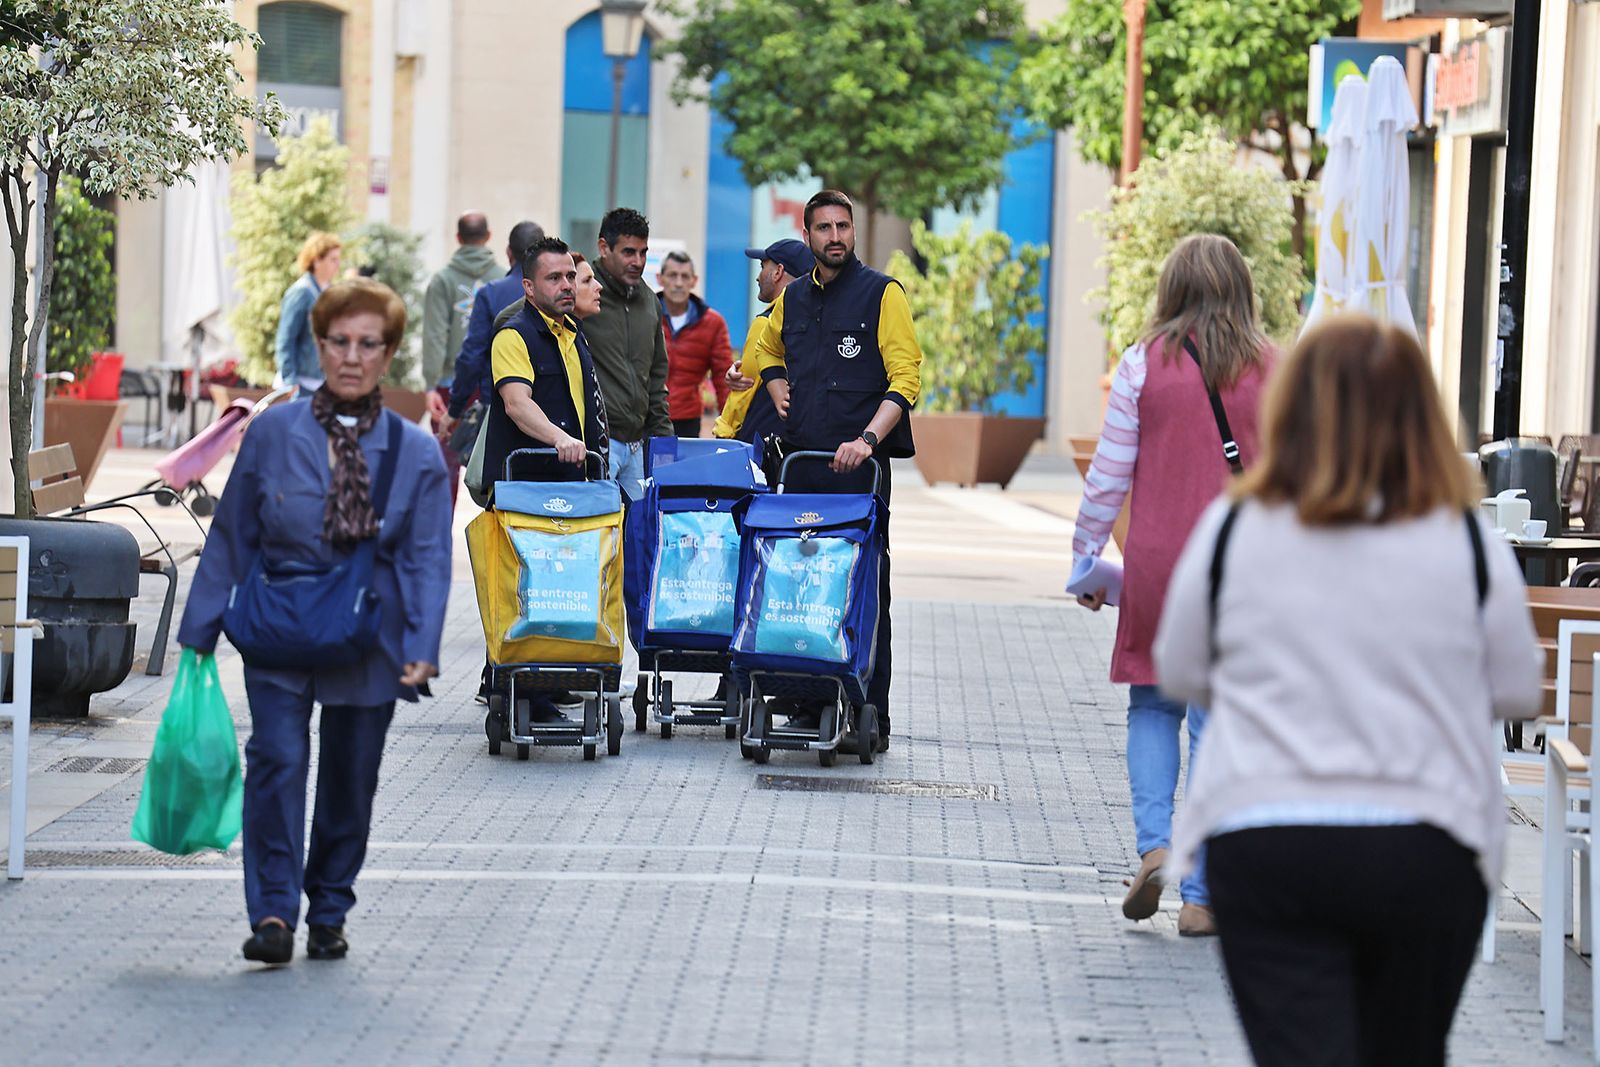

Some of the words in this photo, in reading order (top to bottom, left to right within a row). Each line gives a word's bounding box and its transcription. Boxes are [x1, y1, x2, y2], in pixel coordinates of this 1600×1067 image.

[661, 577, 685, 588] Esta
[687, 579, 733, 592] entrega
[541, 588, 589, 600] entrega
[659, 591, 673, 600] es
[674, 590, 735, 603] sostenible.
[527, 600, 592, 612] sostenible.
[767, 598, 793, 610] Esta
[796, 602, 841, 617] entrega
[764, 612, 778, 621] es
